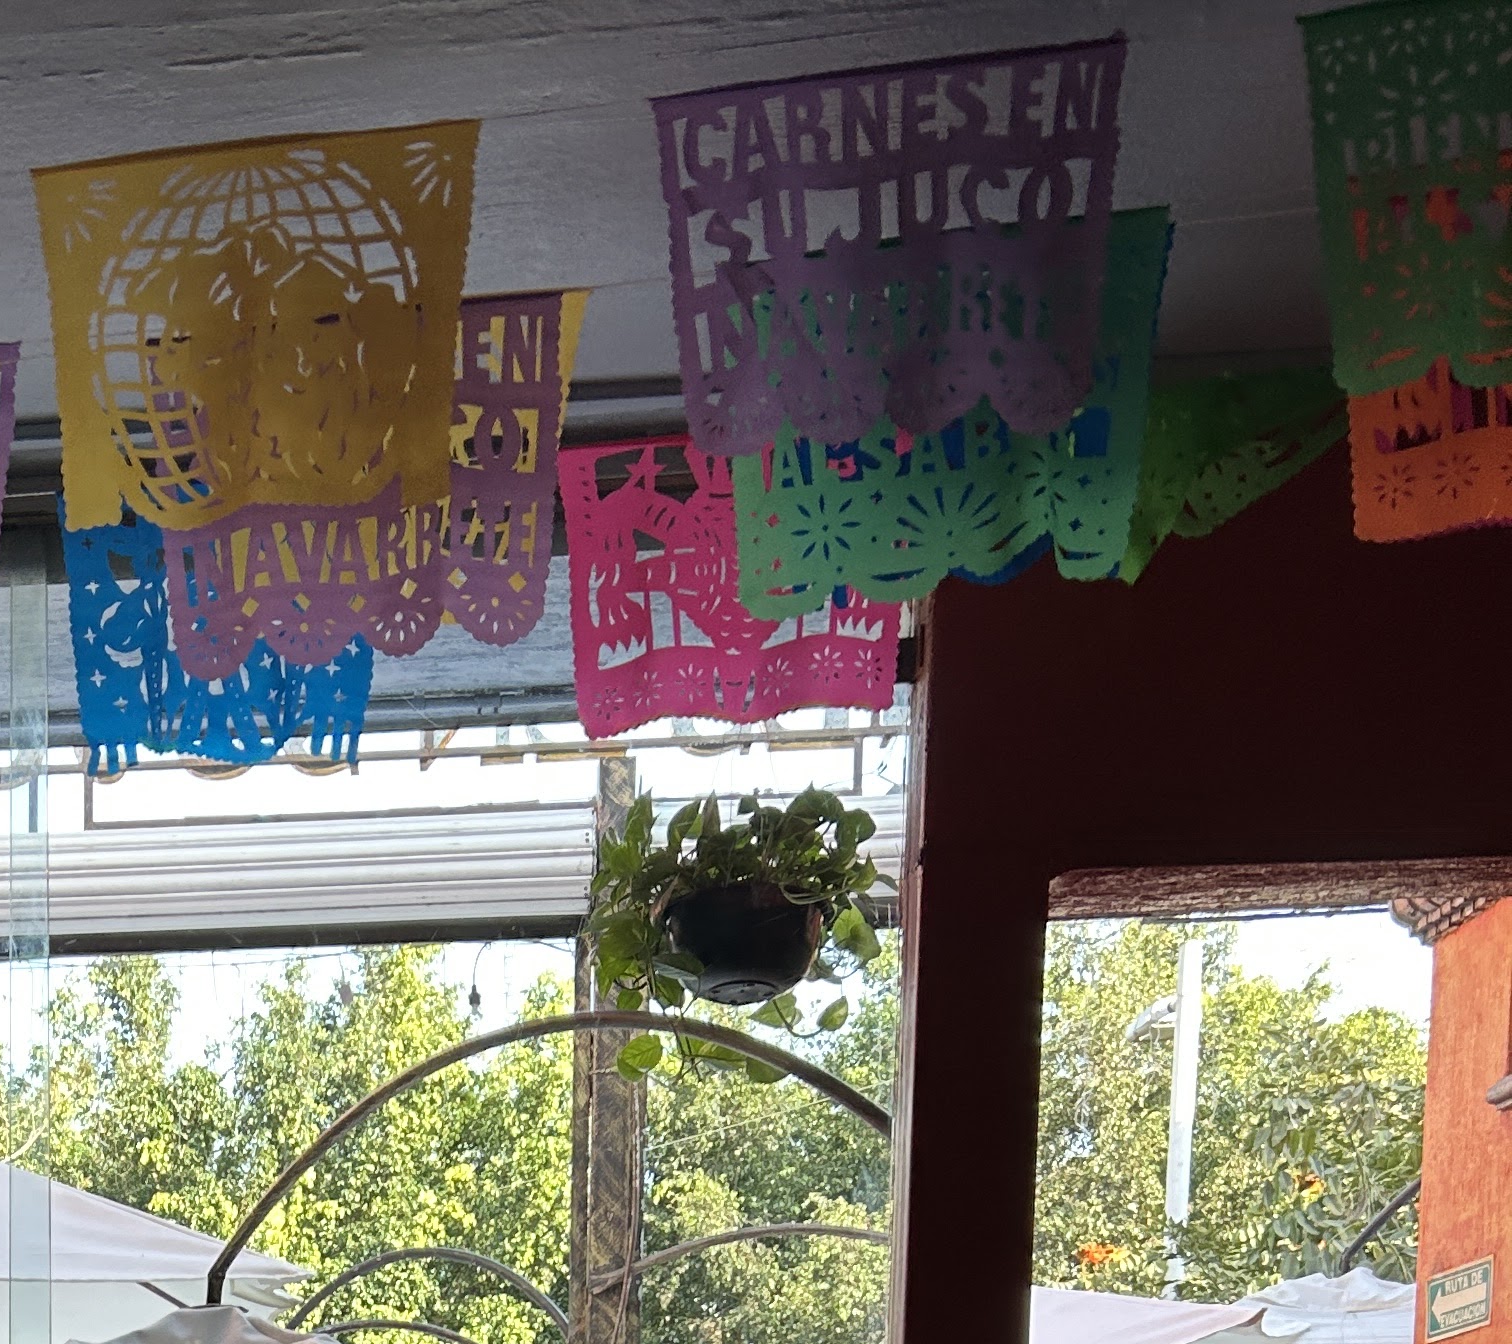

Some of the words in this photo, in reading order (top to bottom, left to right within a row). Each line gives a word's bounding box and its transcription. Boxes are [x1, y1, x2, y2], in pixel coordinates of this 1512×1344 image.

[682, 74, 986, 186] CARNES
[1010, 61, 1095, 138] EN
[194, 500, 532, 606] NAVARRETE
[1445, 1275, 1469, 1293] RUTA
[1471, 1270, 1484, 1286] DE
